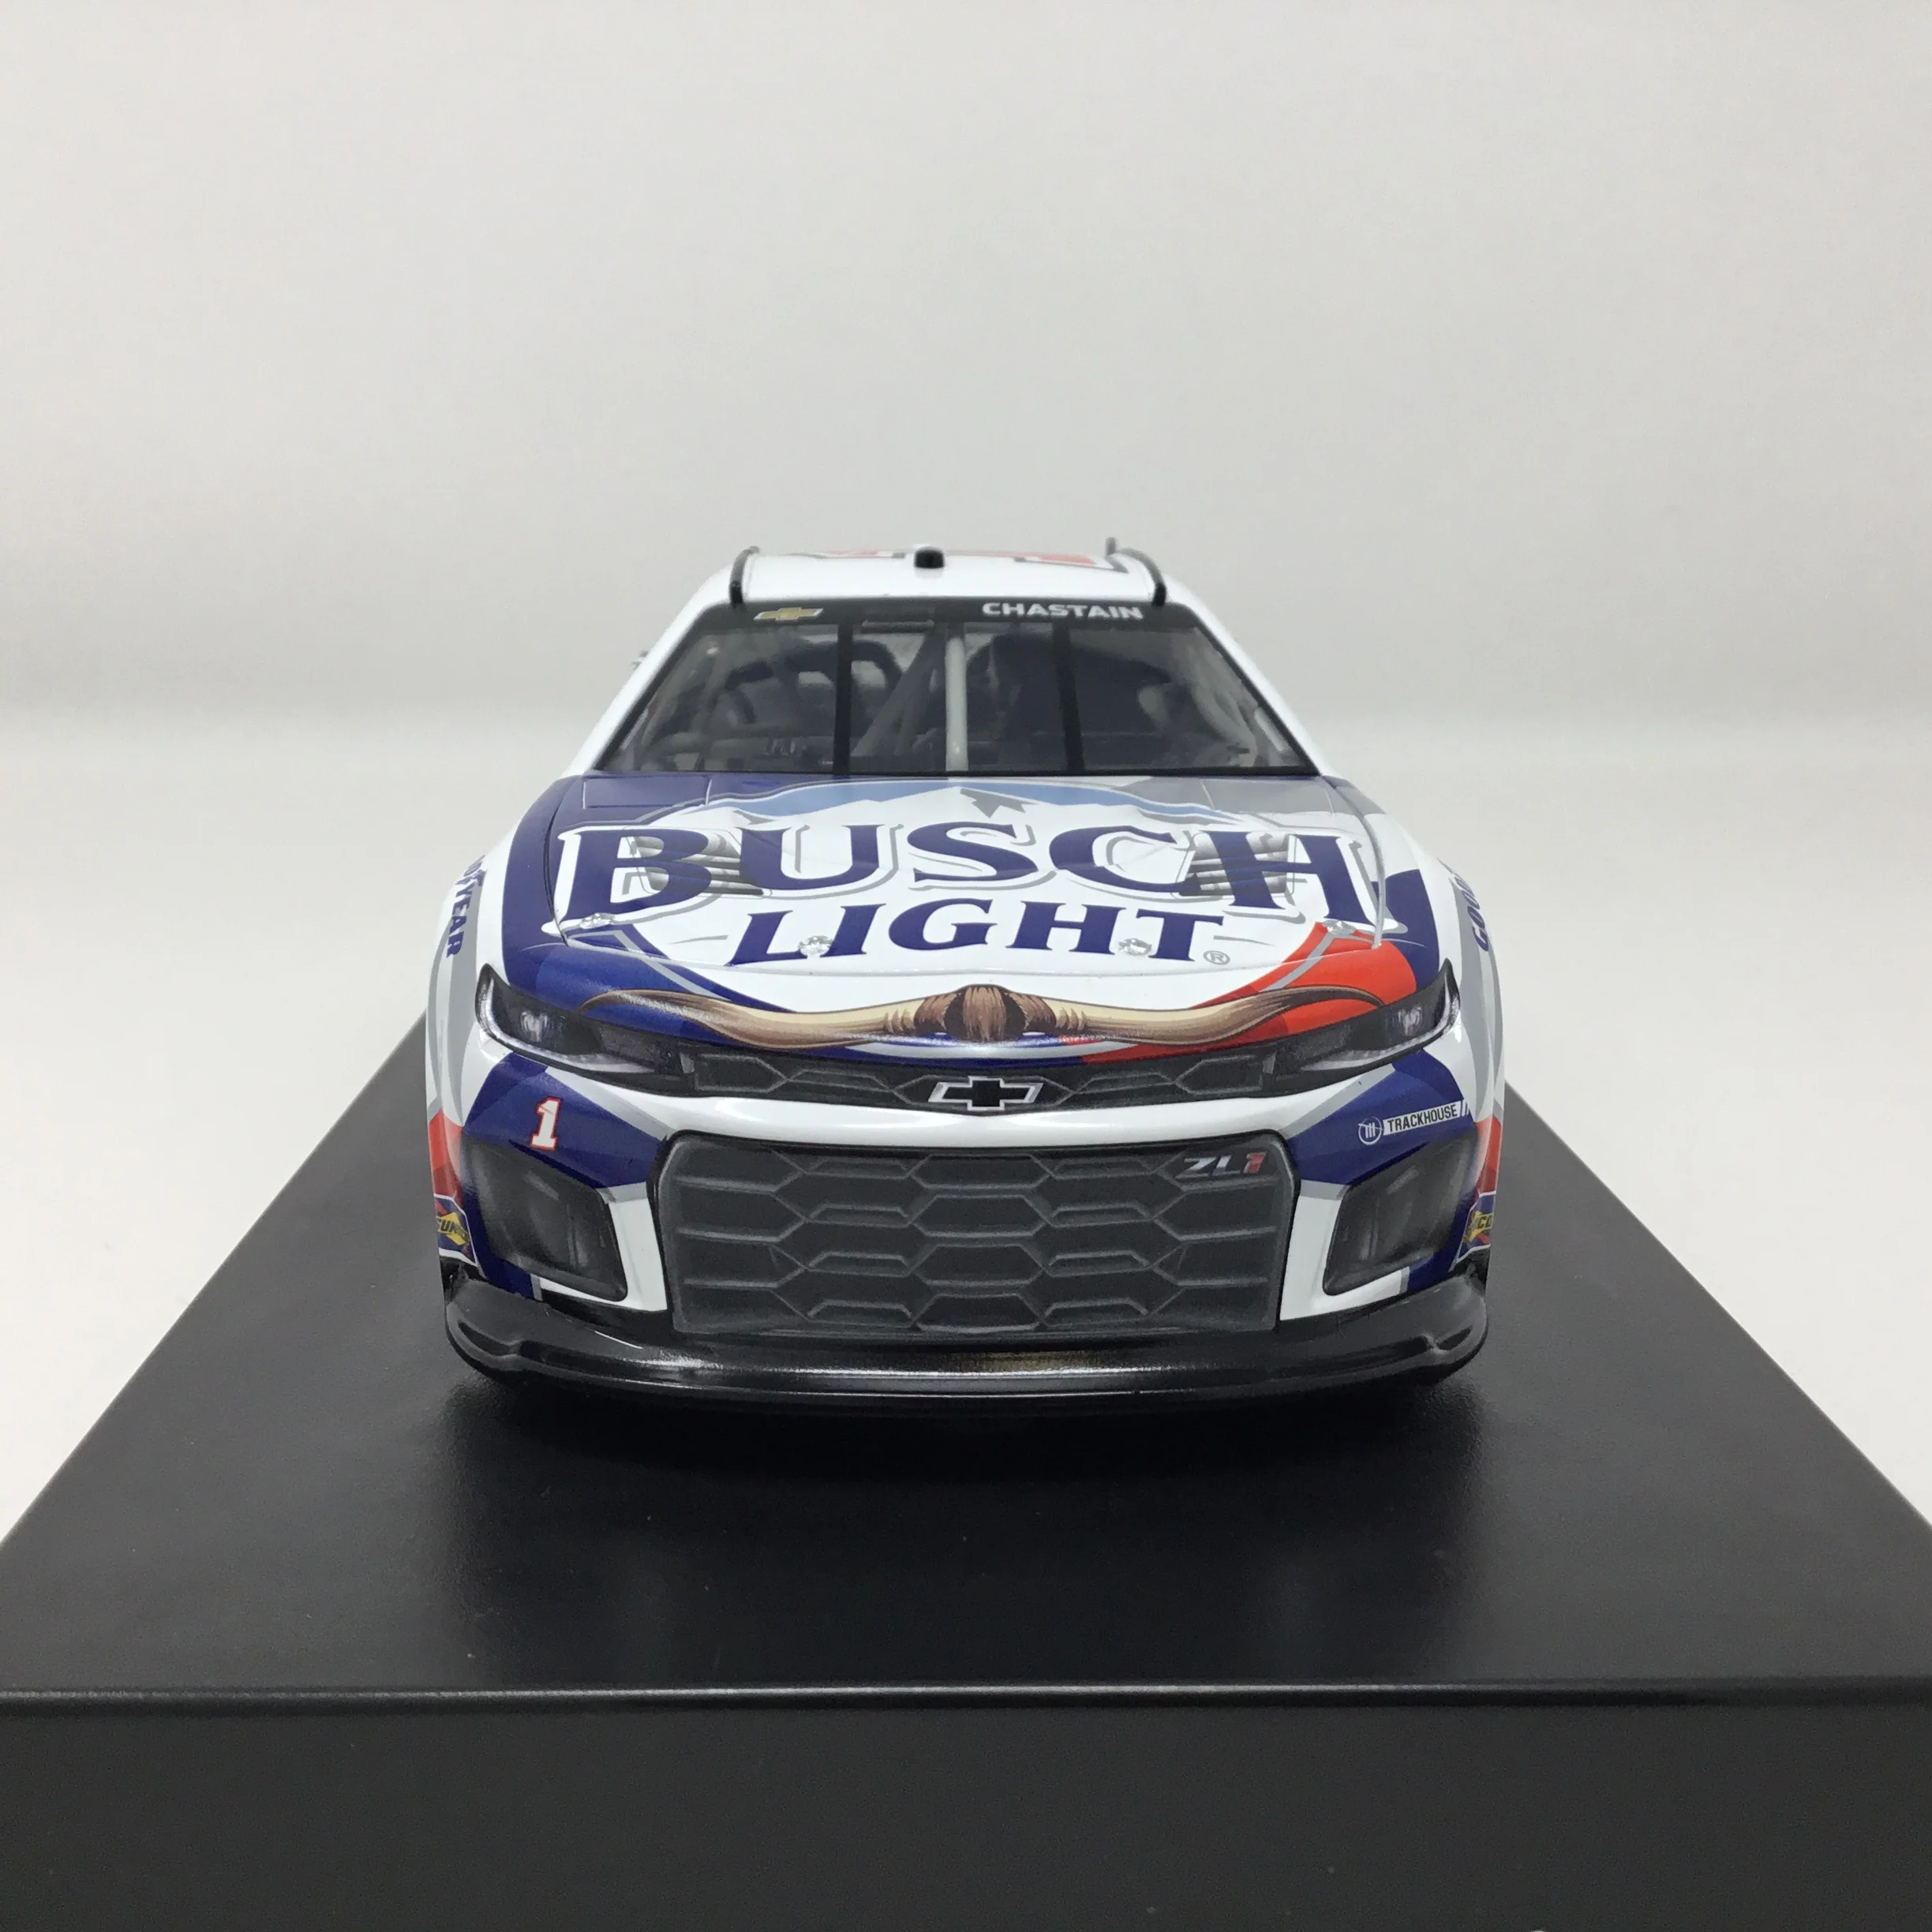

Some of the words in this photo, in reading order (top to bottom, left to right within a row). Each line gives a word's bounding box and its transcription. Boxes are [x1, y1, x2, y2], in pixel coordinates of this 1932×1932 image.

[982, 602, 1144, 620] CHASTAIN
[560, 821, 1385, 927] BUSCH
[724, 898, 1223, 967] LIGHT
[530, 1095, 562, 1151] 1
[1387, 1104, 1458, 1133] TRACKHOUSE
[1175, 1151, 1267, 1179] ZL1
